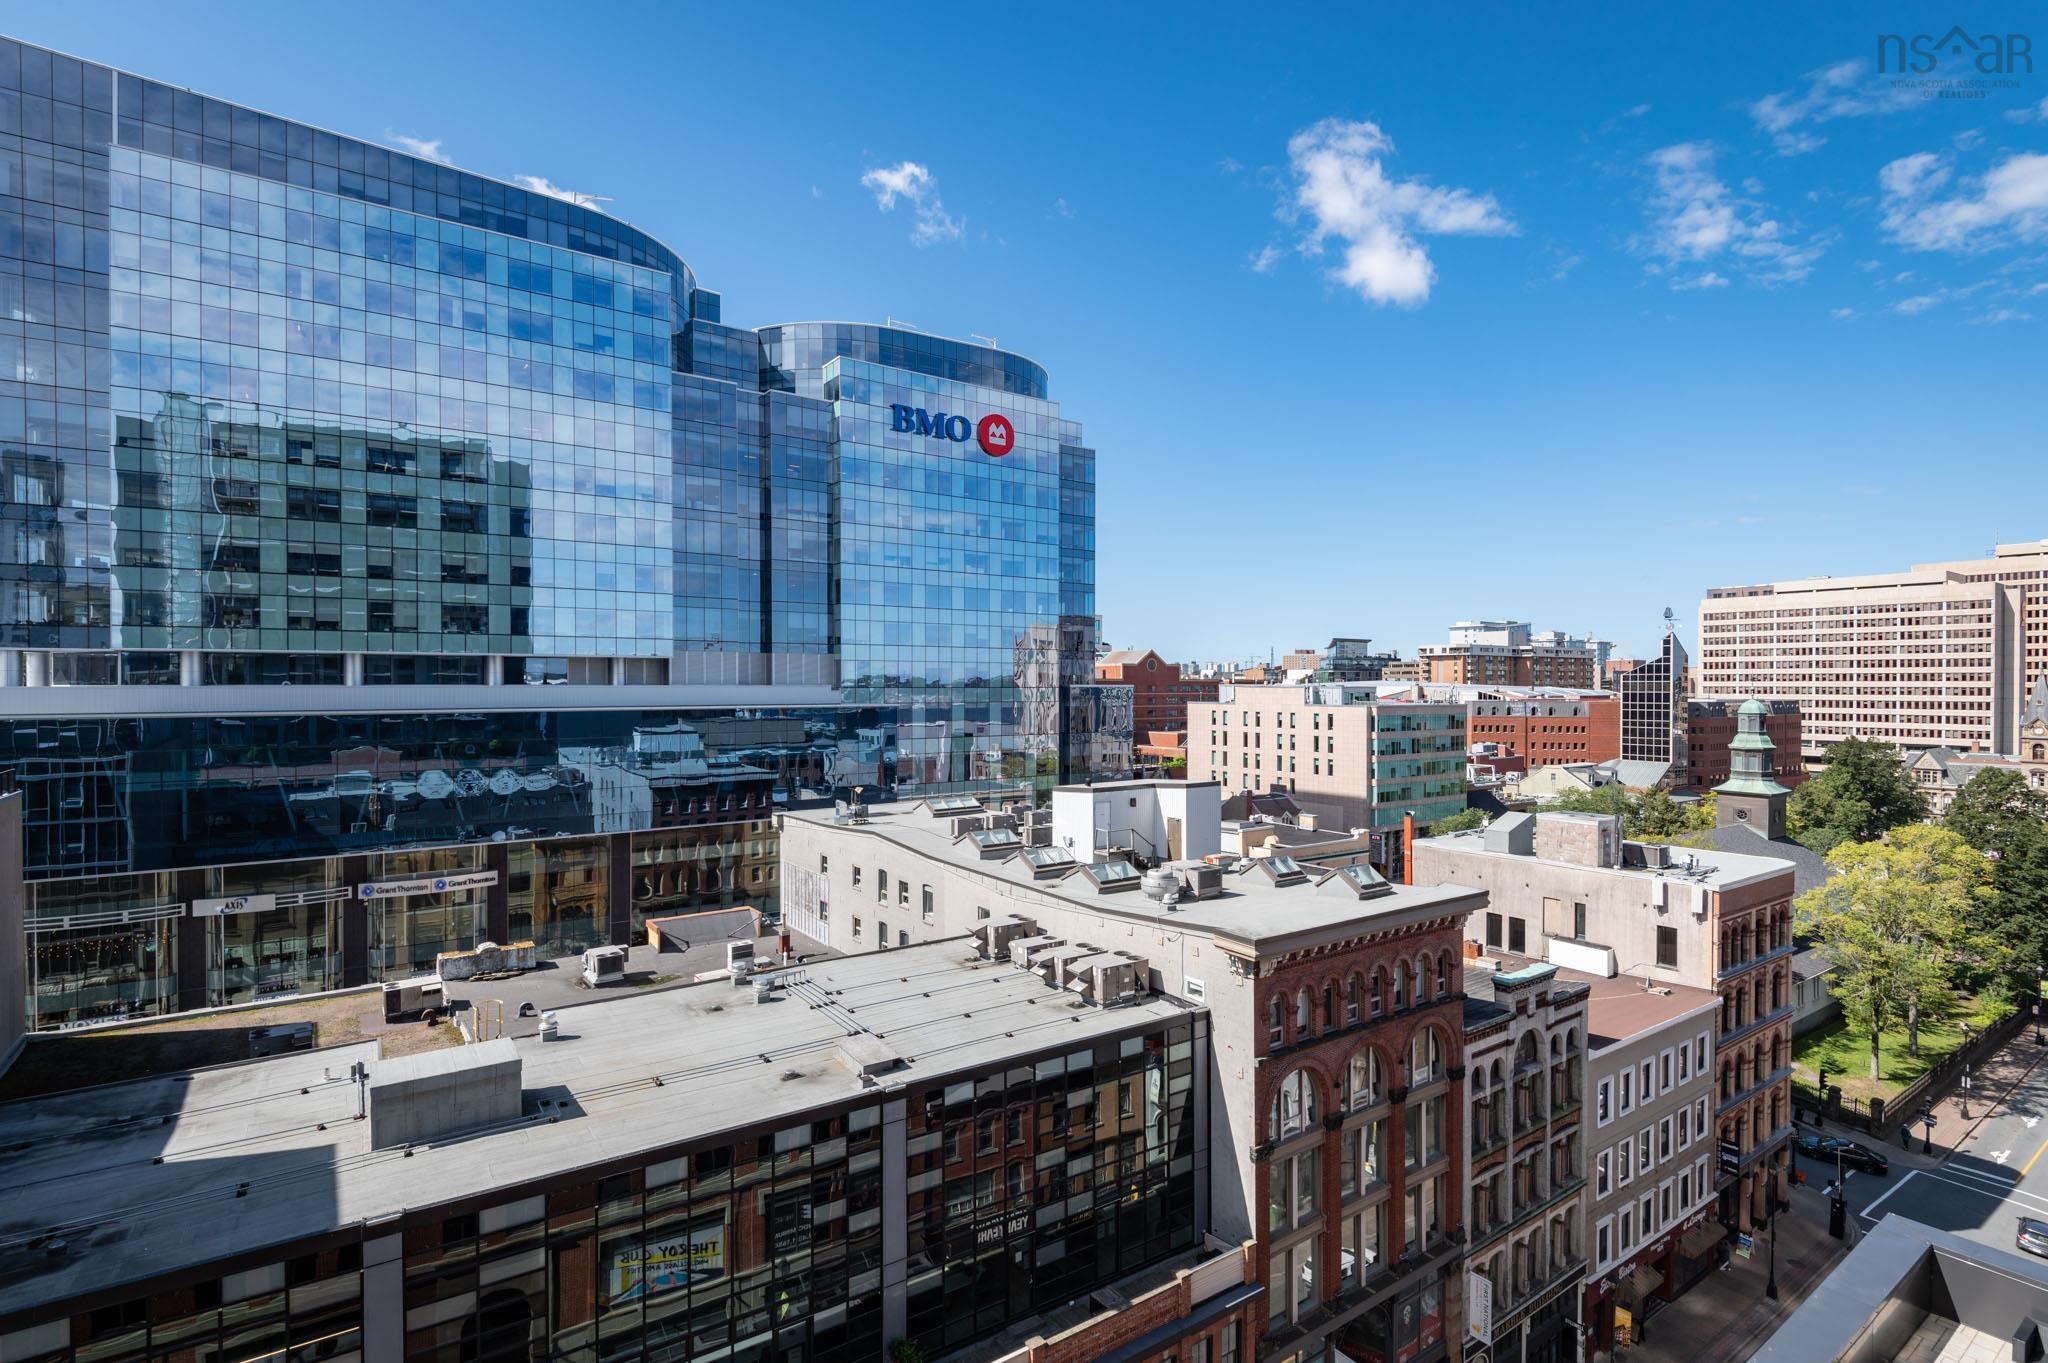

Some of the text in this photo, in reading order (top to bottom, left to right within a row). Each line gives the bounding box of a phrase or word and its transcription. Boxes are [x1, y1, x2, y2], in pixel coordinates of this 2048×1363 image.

[889, 403, 972, 442] BMO
[376, 884, 429, 895] Grant Thornton
[467, 877, 496, 885] Thornton
[1482, 1283, 1490, 1337] FIRST NATIONAL
